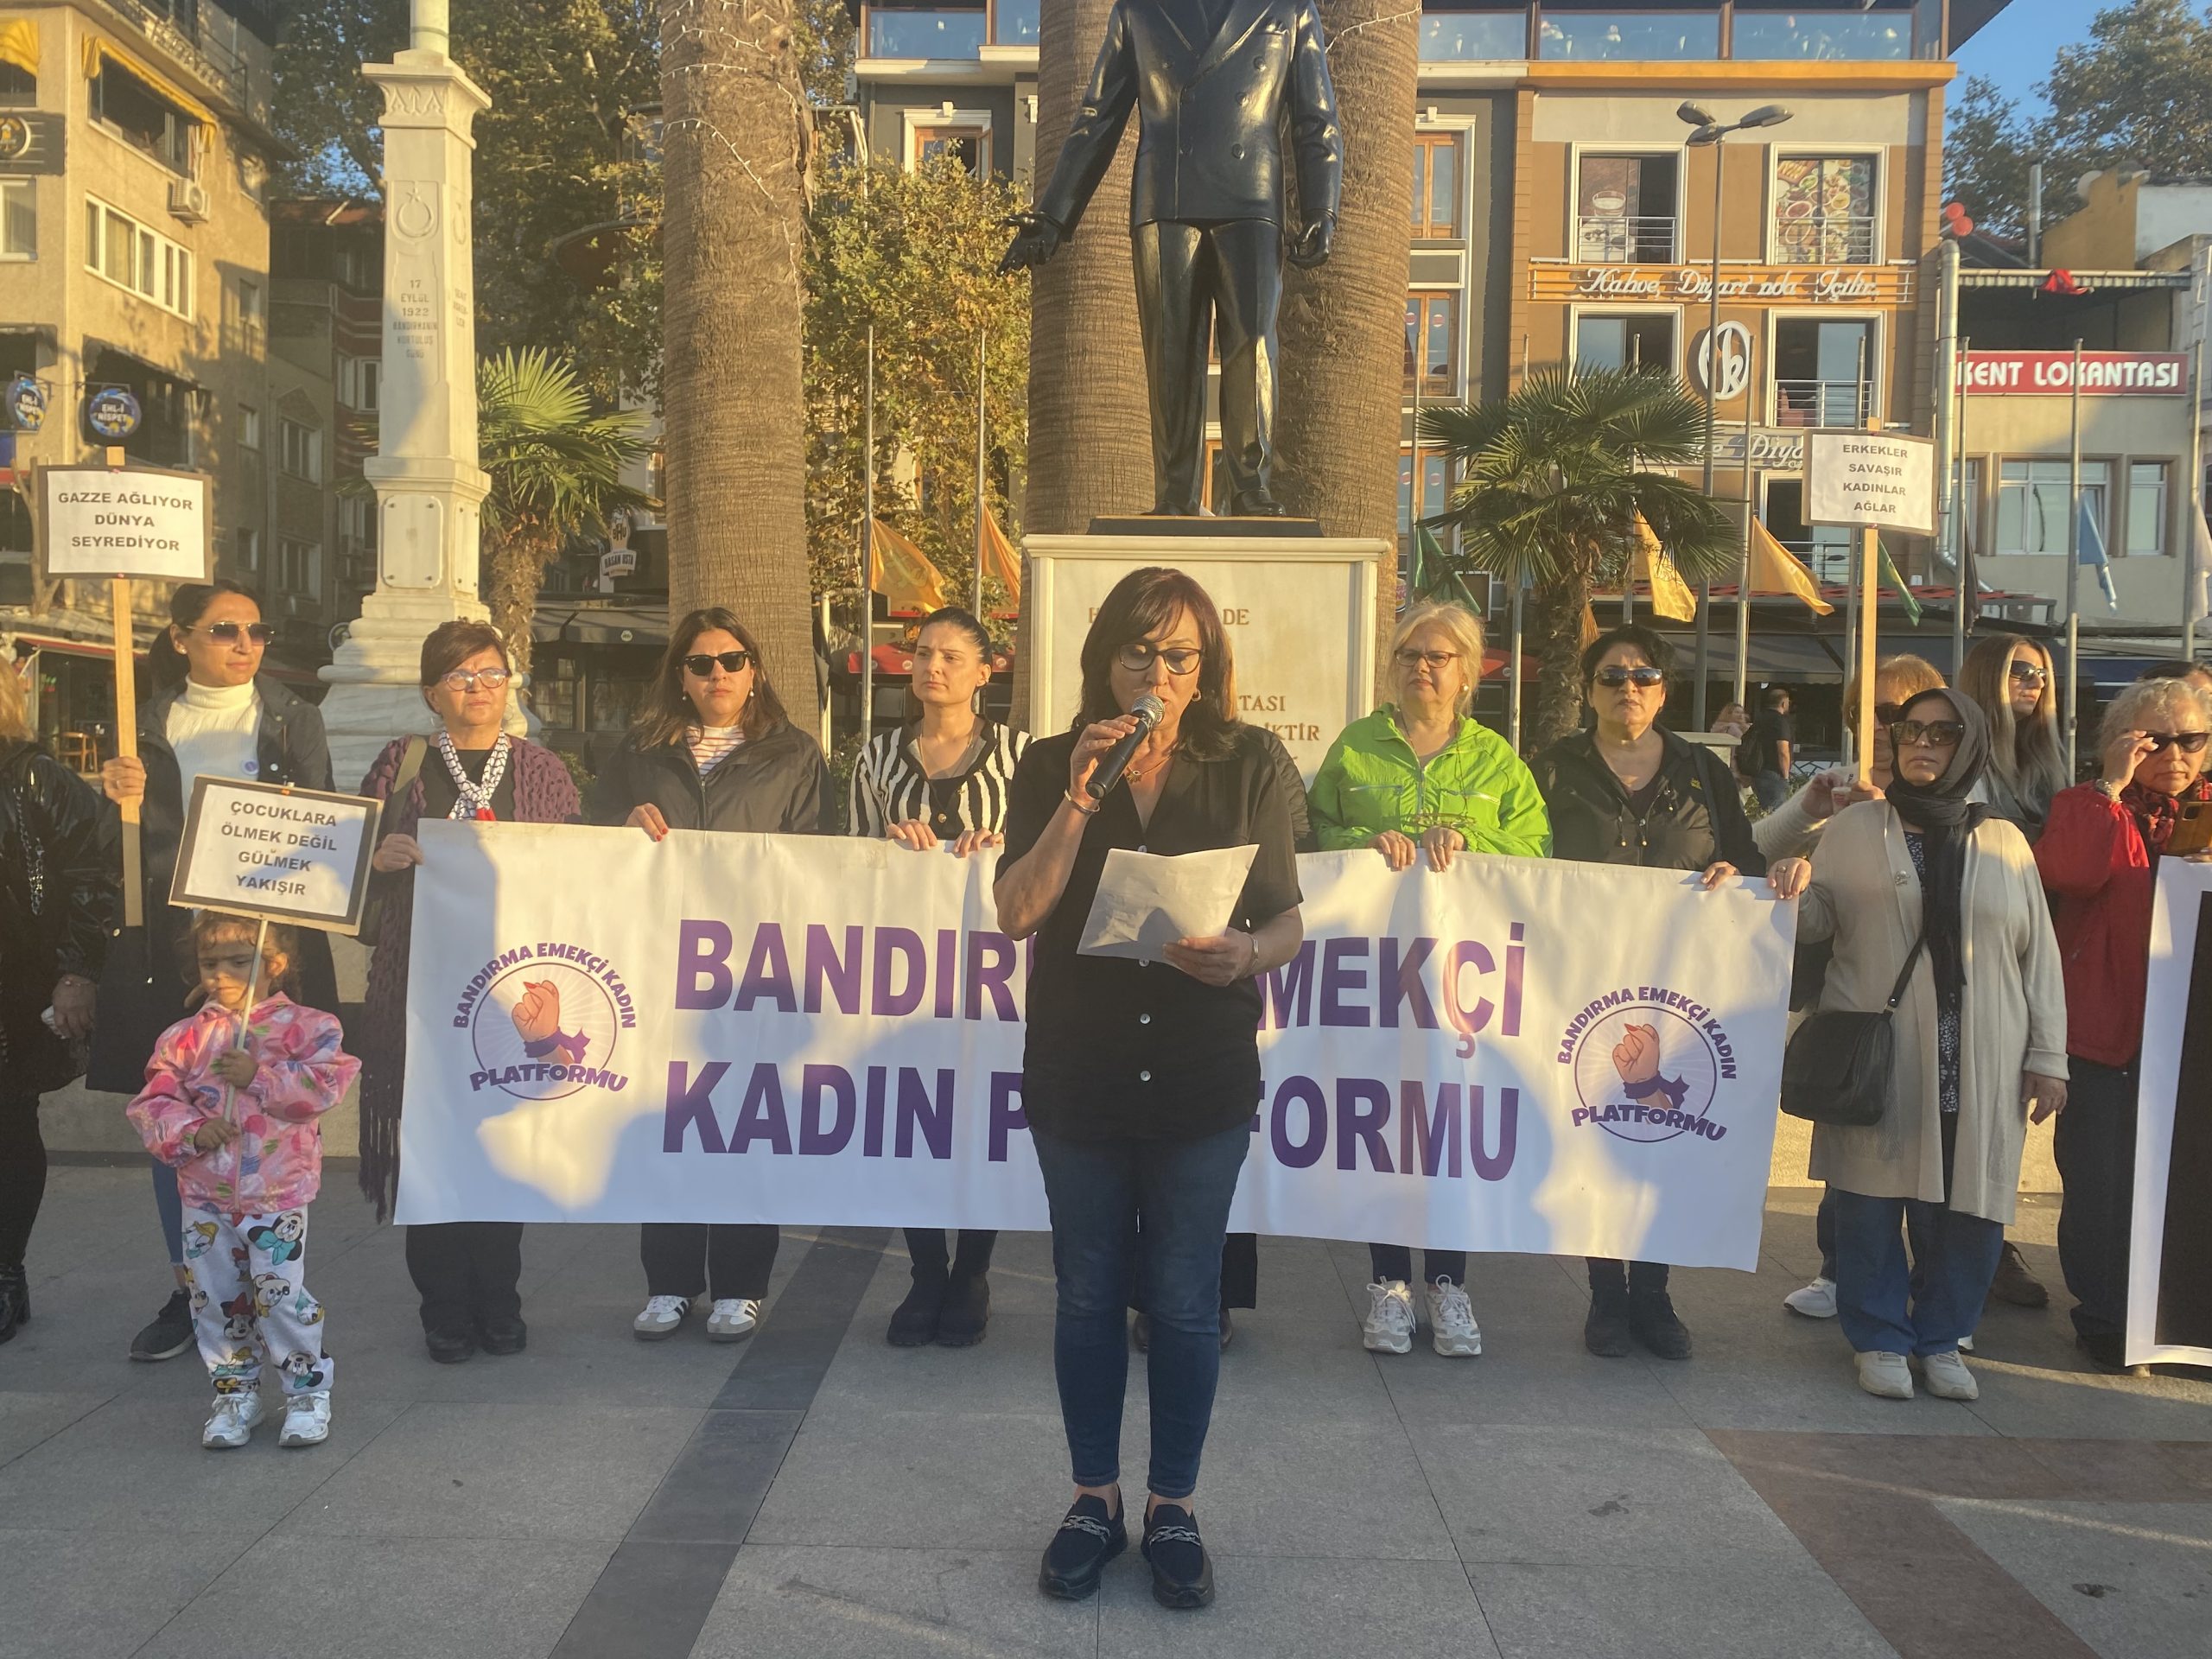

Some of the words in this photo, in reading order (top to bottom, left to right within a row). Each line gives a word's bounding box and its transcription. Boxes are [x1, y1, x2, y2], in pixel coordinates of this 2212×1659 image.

[410, 279, 422, 289] 17
[403, 308, 429, 317] 1922
[1957, 361, 2024, 386] KENT
[2034, 360, 2180, 387] LOKANTASI
[1842, 444, 1908, 458] ERKEKLER
[1848, 463, 1902, 476] SAVAŞIR
[1843, 482, 1906, 496] KADINLAR
[58, 493, 111, 504] GAZZE
[117, 491, 193, 511] AĞLIYOR
[1853, 500, 1897, 513] AĞLAR
[95, 512, 155, 527] DÜNYA
[71, 535, 180, 551] SEYREDİYOR
[1236, 695, 1287, 712] TASI
[230, 801, 337, 827] ÇOCUKLARA
[220, 822, 282, 843] ÖLMEK
[286, 834, 338, 851] DEĞİL
[238, 850, 312, 872] GÜLMEK
[236, 874, 306, 896] YAKIŞIR
[453, 945, 533, 1028] BANDIRMA
[537, 942, 609, 974] EMEKÇİ
[601, 969, 636, 1028] KADIN
[675, 919, 1036, 1022] BANDIR
[1255, 922, 1525, 1059] MEKÇİ
[1557, 988, 1635, 1065] BANDIRMA
[1638, 986, 1711, 1022] EMEKÇİ
[1702, 1018, 1737, 1080] KADIN
[469, 1063, 628, 1092] PLATFORMU
[663, 1060, 955, 1160] KADIN
[1571, 1104, 1727, 1141] PLATFORMU
